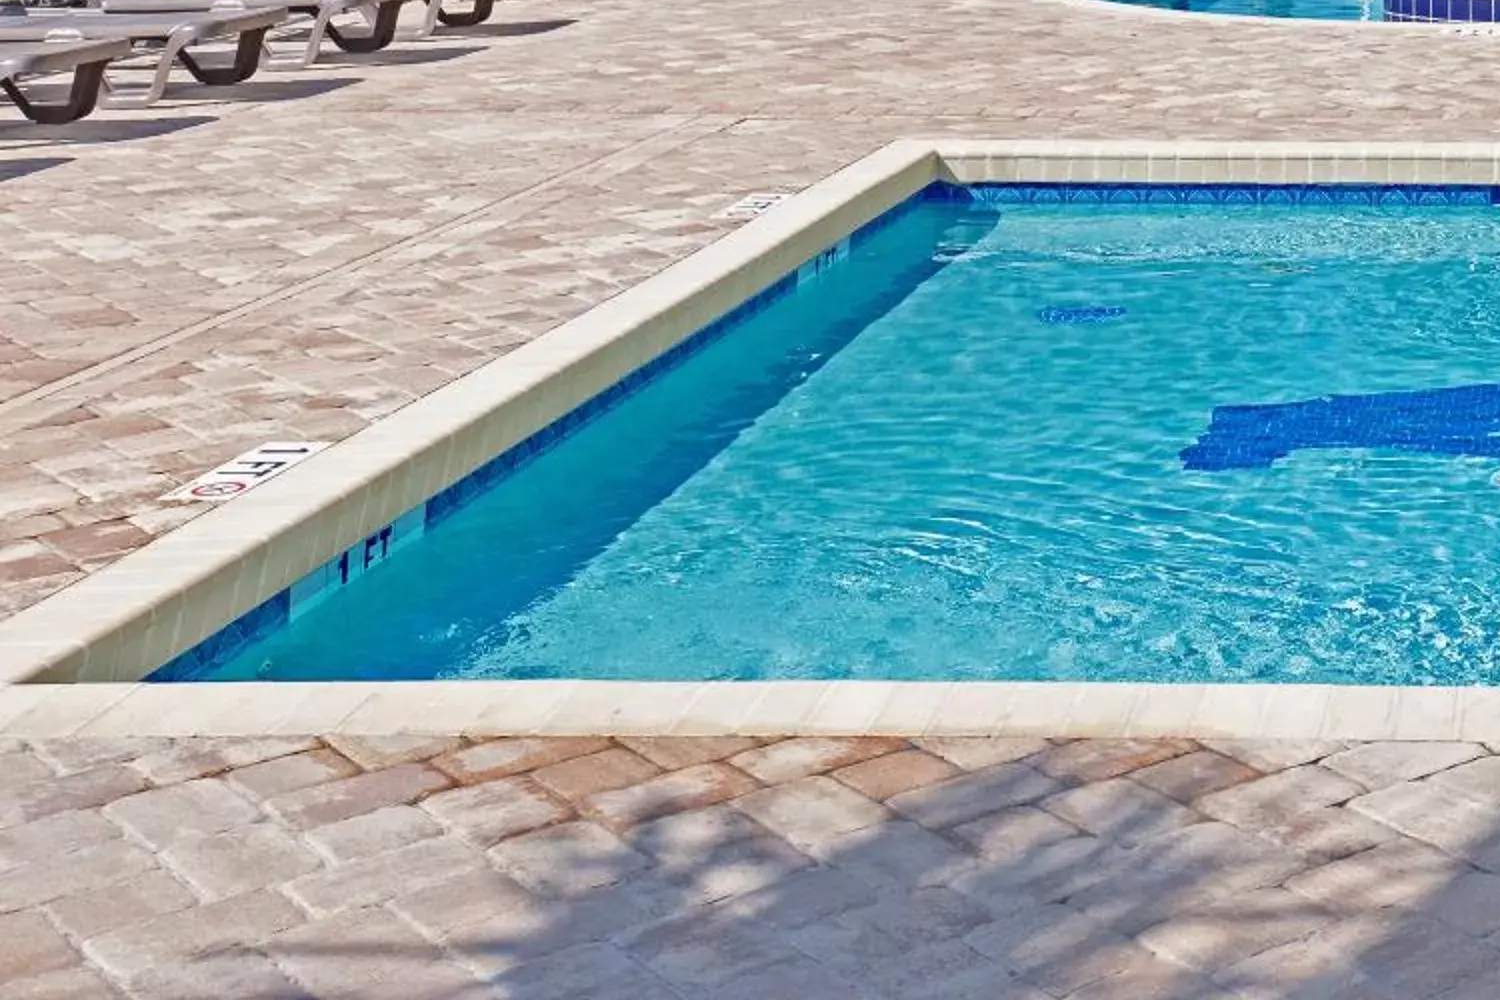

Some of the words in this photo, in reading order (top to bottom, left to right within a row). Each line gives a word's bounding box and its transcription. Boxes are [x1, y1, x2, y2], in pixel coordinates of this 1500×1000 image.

[217, 461, 288, 478] FT
[338, 550, 349, 585] 1
[363, 523, 394, 568] FT
